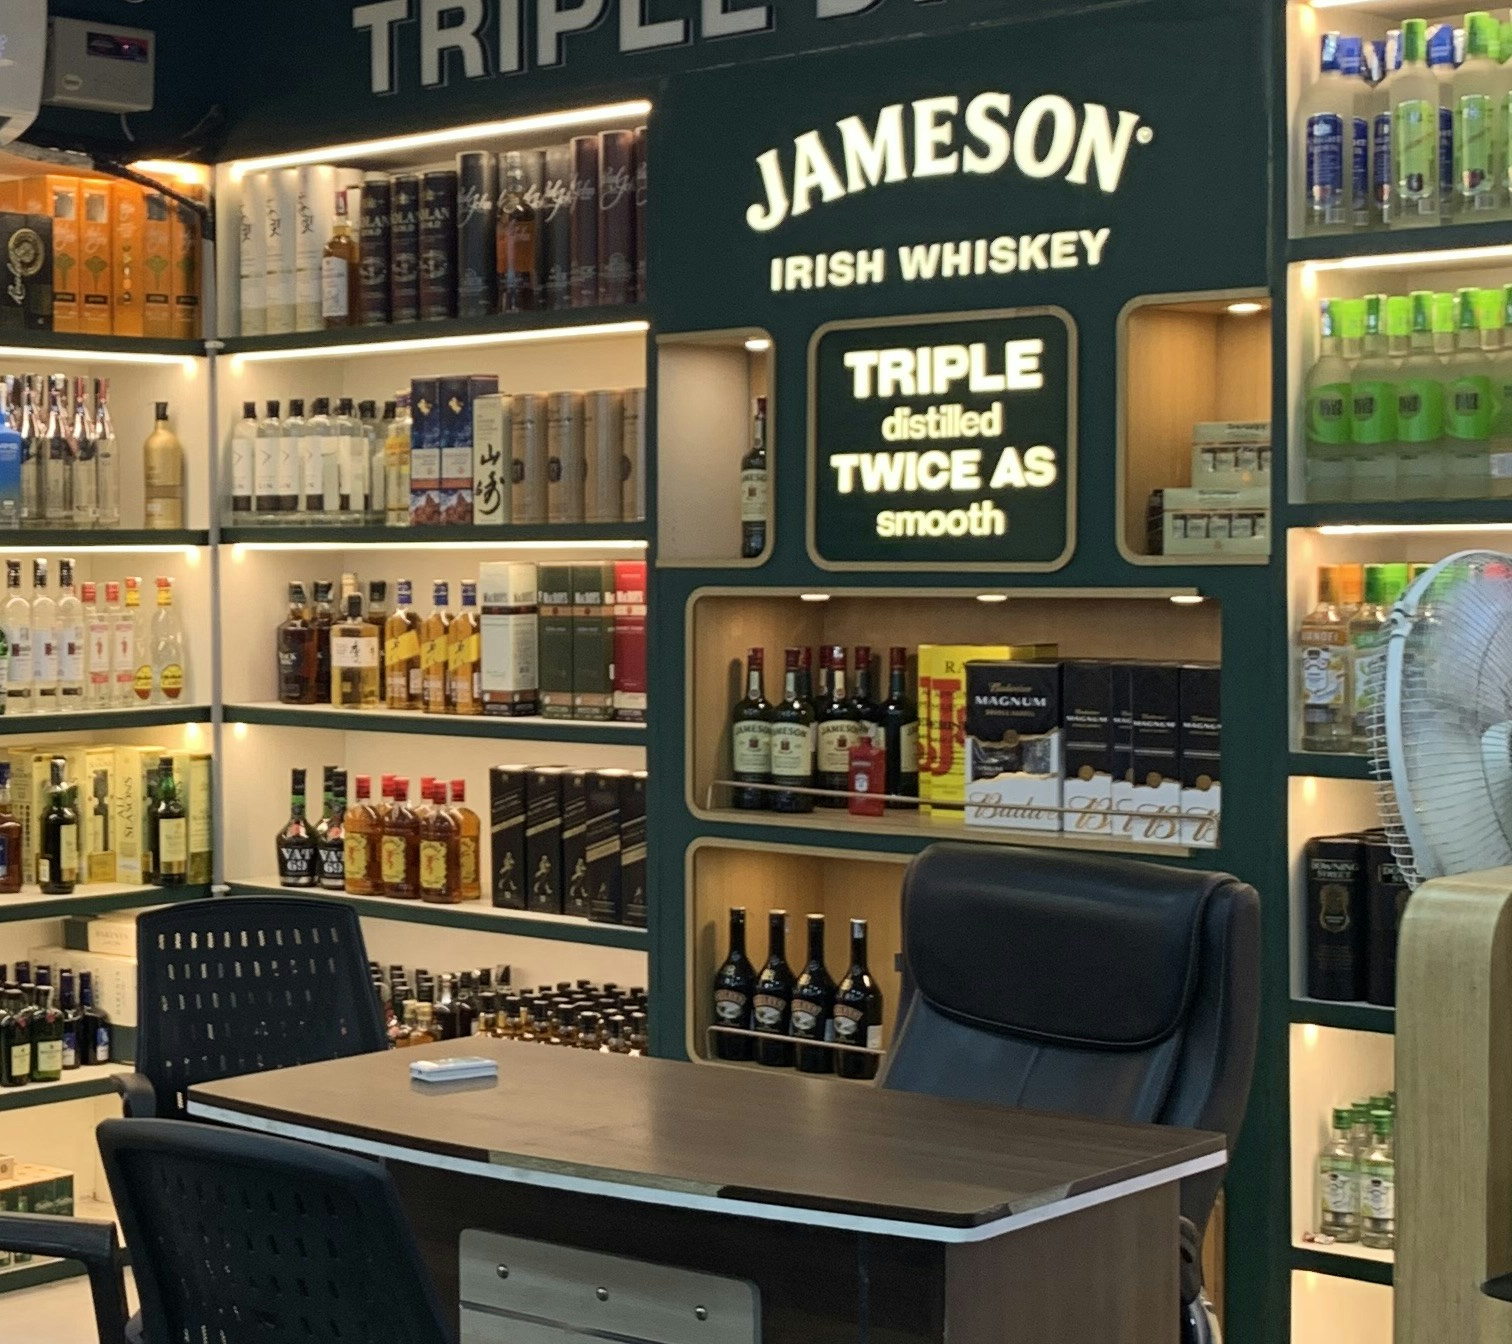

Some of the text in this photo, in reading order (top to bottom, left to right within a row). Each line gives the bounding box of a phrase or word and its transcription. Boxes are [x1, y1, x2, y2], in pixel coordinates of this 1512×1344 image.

[745, 91, 1142, 232] JAMESON
[769, 227, 1111, 292] IRISH WHISKEY
[843, 338, 1045, 400] TRIPLE
[881, 401, 1004, 442] distilled
[829, 445, 1058, 494] TWICE AS
[875, 500, 1007, 539] smooth
[974, 695, 1047, 707] MAGNUM
[280, 847, 315, 860] VAT
[287, 860, 309, 871] 69
[323, 862, 344, 873] 69
